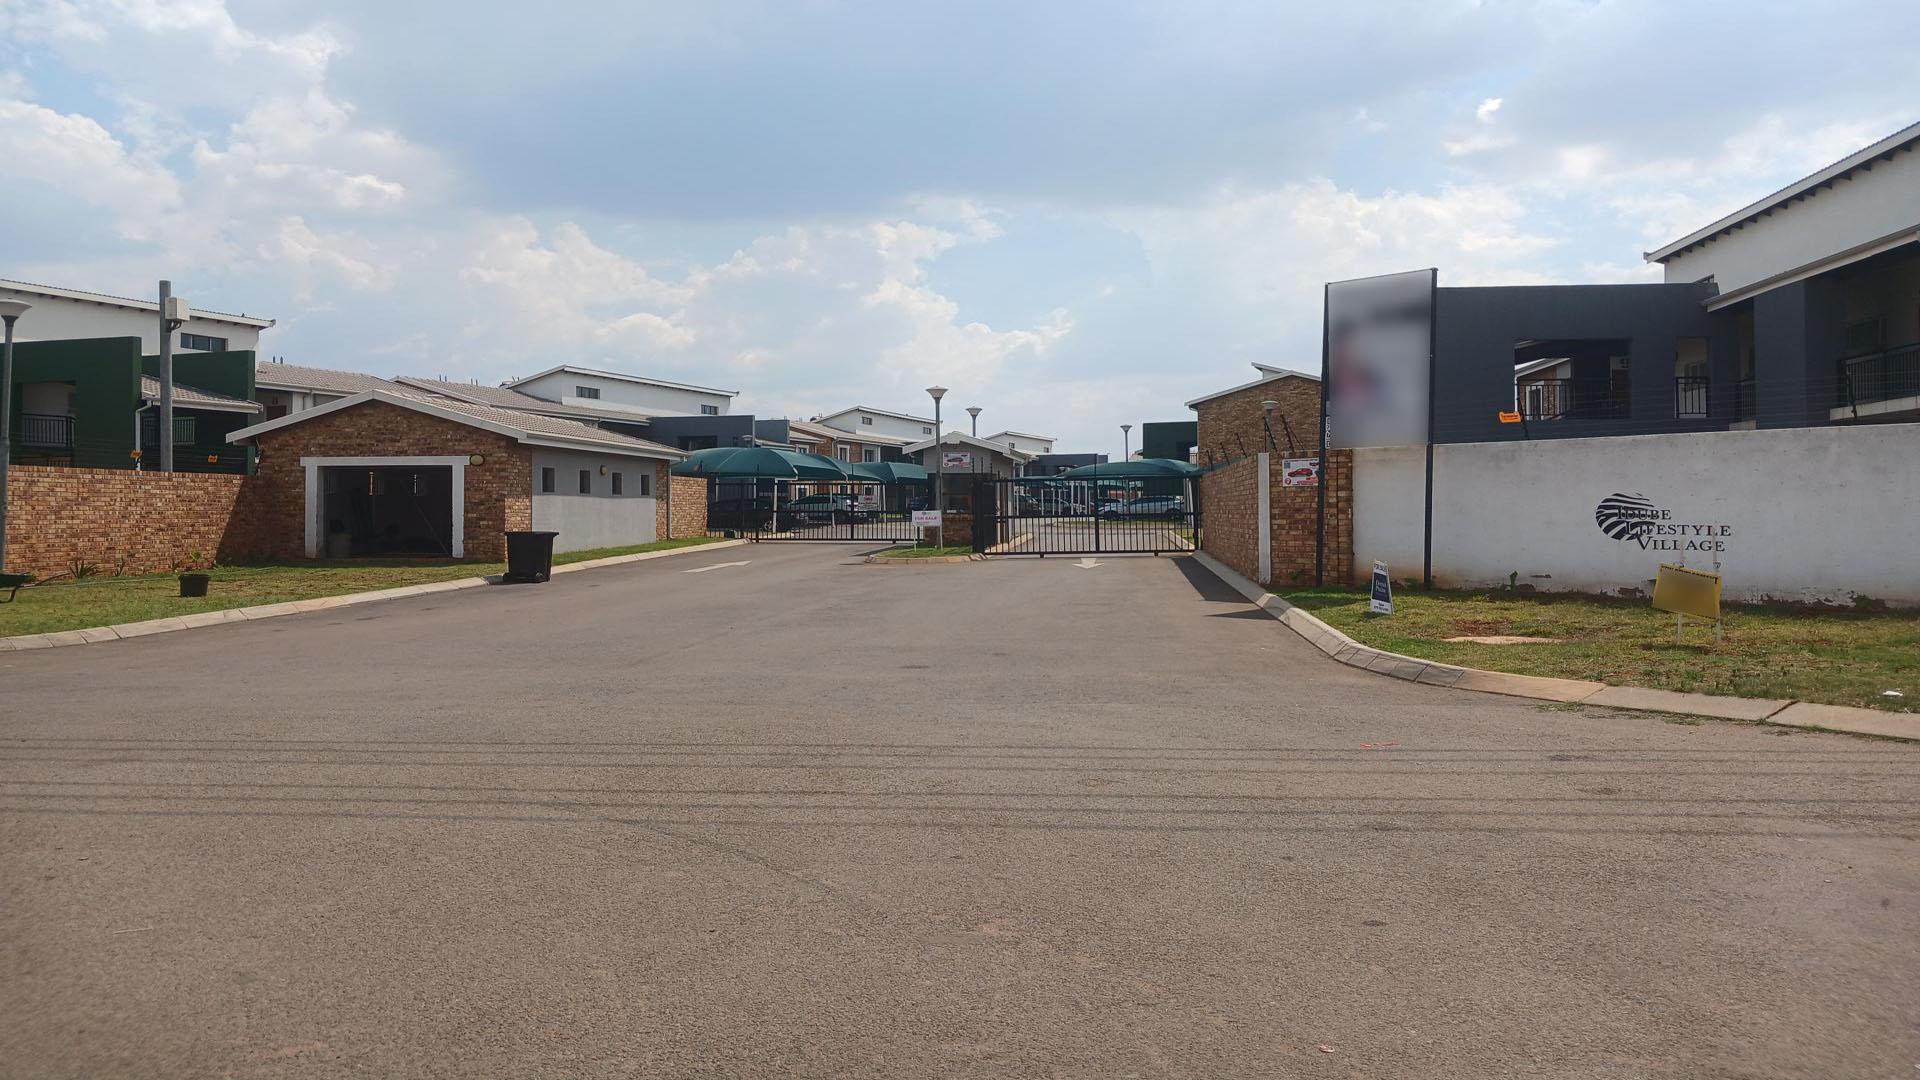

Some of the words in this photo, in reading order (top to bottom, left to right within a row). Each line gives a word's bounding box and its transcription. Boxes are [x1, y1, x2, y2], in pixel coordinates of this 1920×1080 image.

[1617, 505, 1671, 520] IDUBE
[1625, 521, 1731, 536] LIFESTYLE
[1637, 536, 1725, 551] VILLAGE
